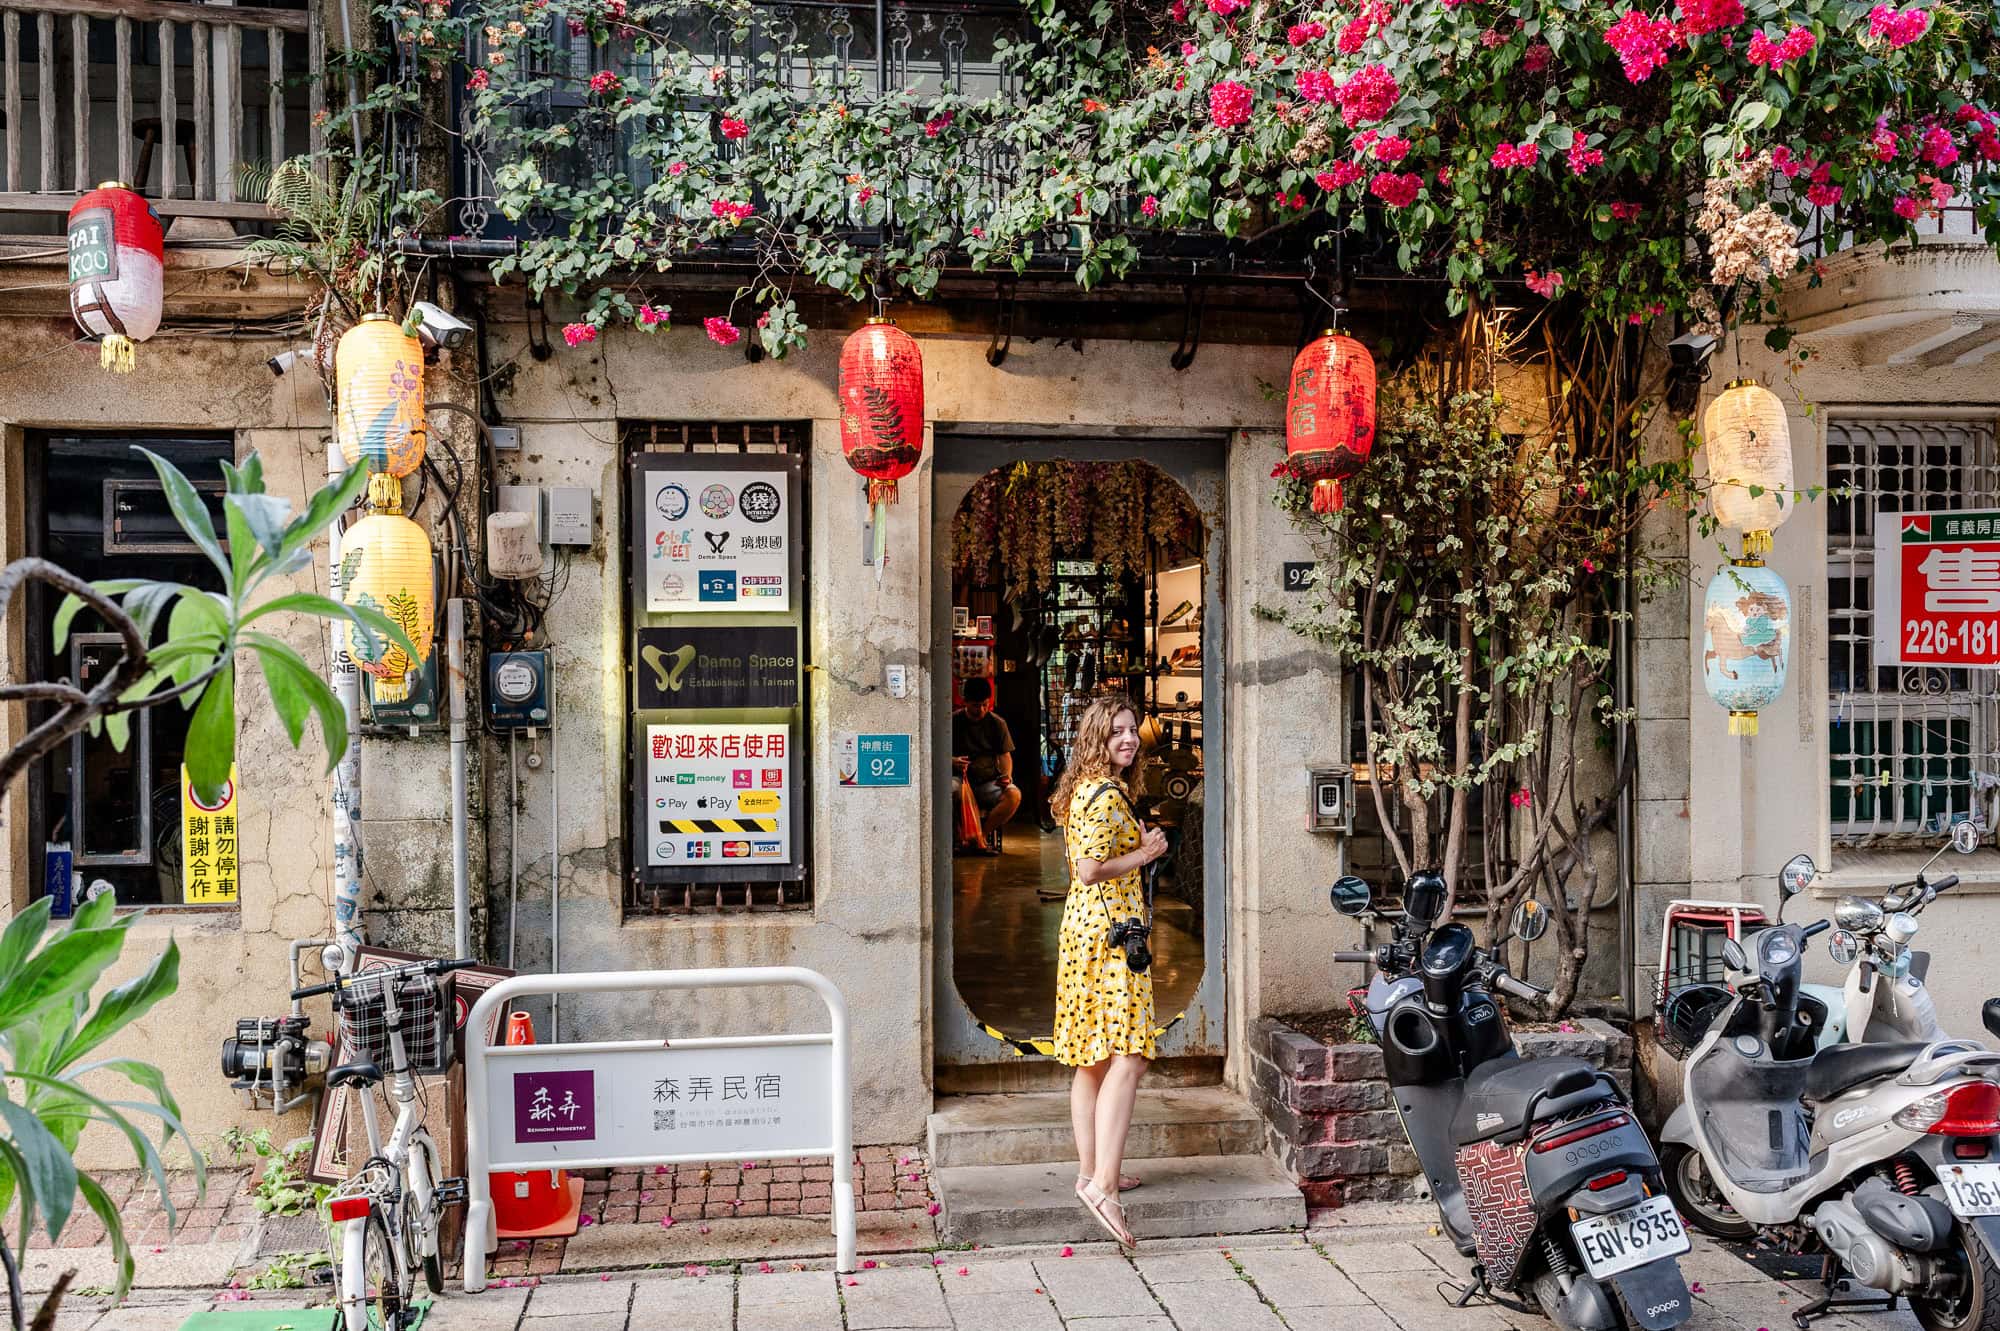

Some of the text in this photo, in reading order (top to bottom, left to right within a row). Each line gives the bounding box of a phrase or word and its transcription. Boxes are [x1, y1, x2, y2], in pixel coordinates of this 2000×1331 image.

[69, 226, 99, 251] TAI
[70, 250, 108, 280] KOO
[1290, 569, 1311, 585] 92
[1906, 619, 1998, 656] 226-181
[749, 654, 794, 670] Space
[688, 677, 745, 688] Established
[761, 677, 795, 687] Tainan
[652, 734, 785, 759] 歡迎來店使用
[861, 741, 893, 753] 神農街
[871, 759, 895, 777] 92
[655, 775, 726, 784] LINE Pay money
[668, 798, 688, 811] Pay
[710, 796, 732, 811] Pay
[189, 816, 211, 898] 謝謝合作
[215, 816, 236, 896] 請勿停車
[653, 1073, 781, 1103] 森弄民宿
[528, 1087, 580, 1121] 森弄
